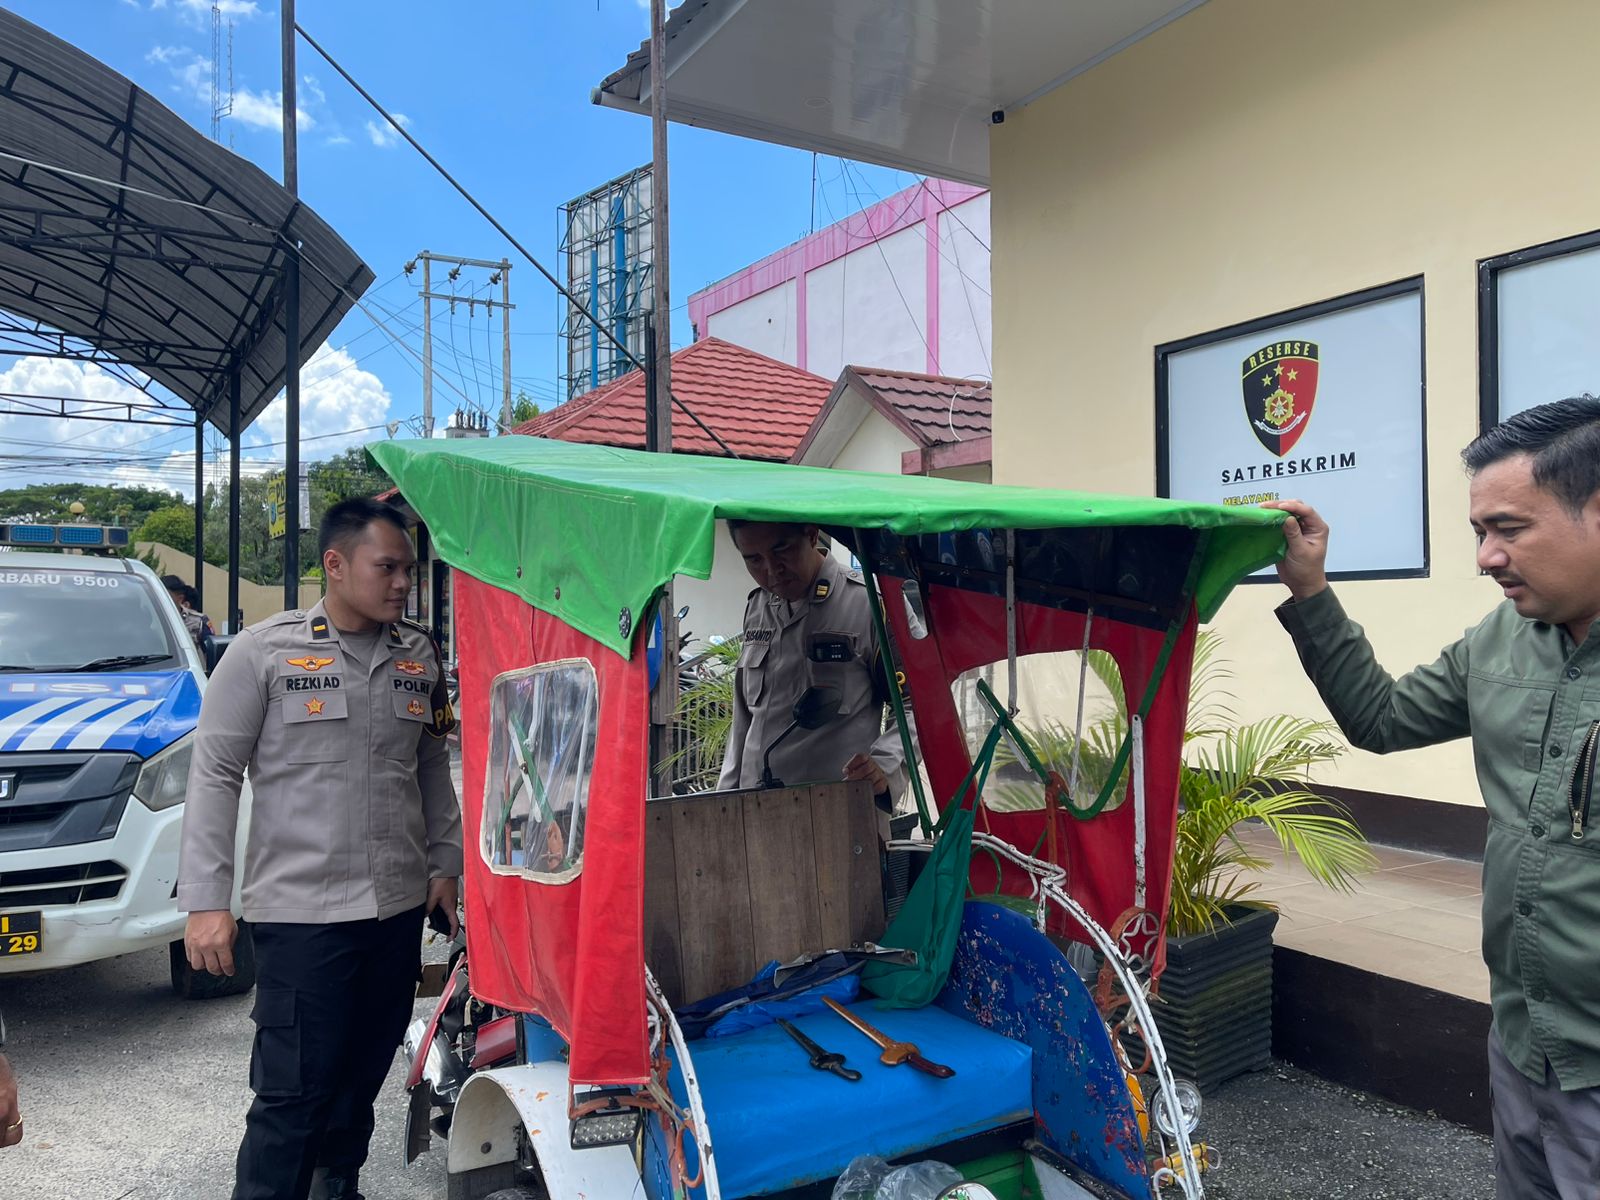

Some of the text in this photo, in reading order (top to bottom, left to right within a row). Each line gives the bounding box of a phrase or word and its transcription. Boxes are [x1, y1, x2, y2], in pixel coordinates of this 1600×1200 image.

[1249, 342, 1310, 368] RESERSE
[1222, 451, 1356, 483] SAT RESKRIM
[73, 575, 119, 588] 9500
[744, 629, 772, 642] SUSANTO
[286, 677, 340, 691] REZKI AD
[393, 679, 430, 695] POLRI
[8, 935, 38, 953] 29
